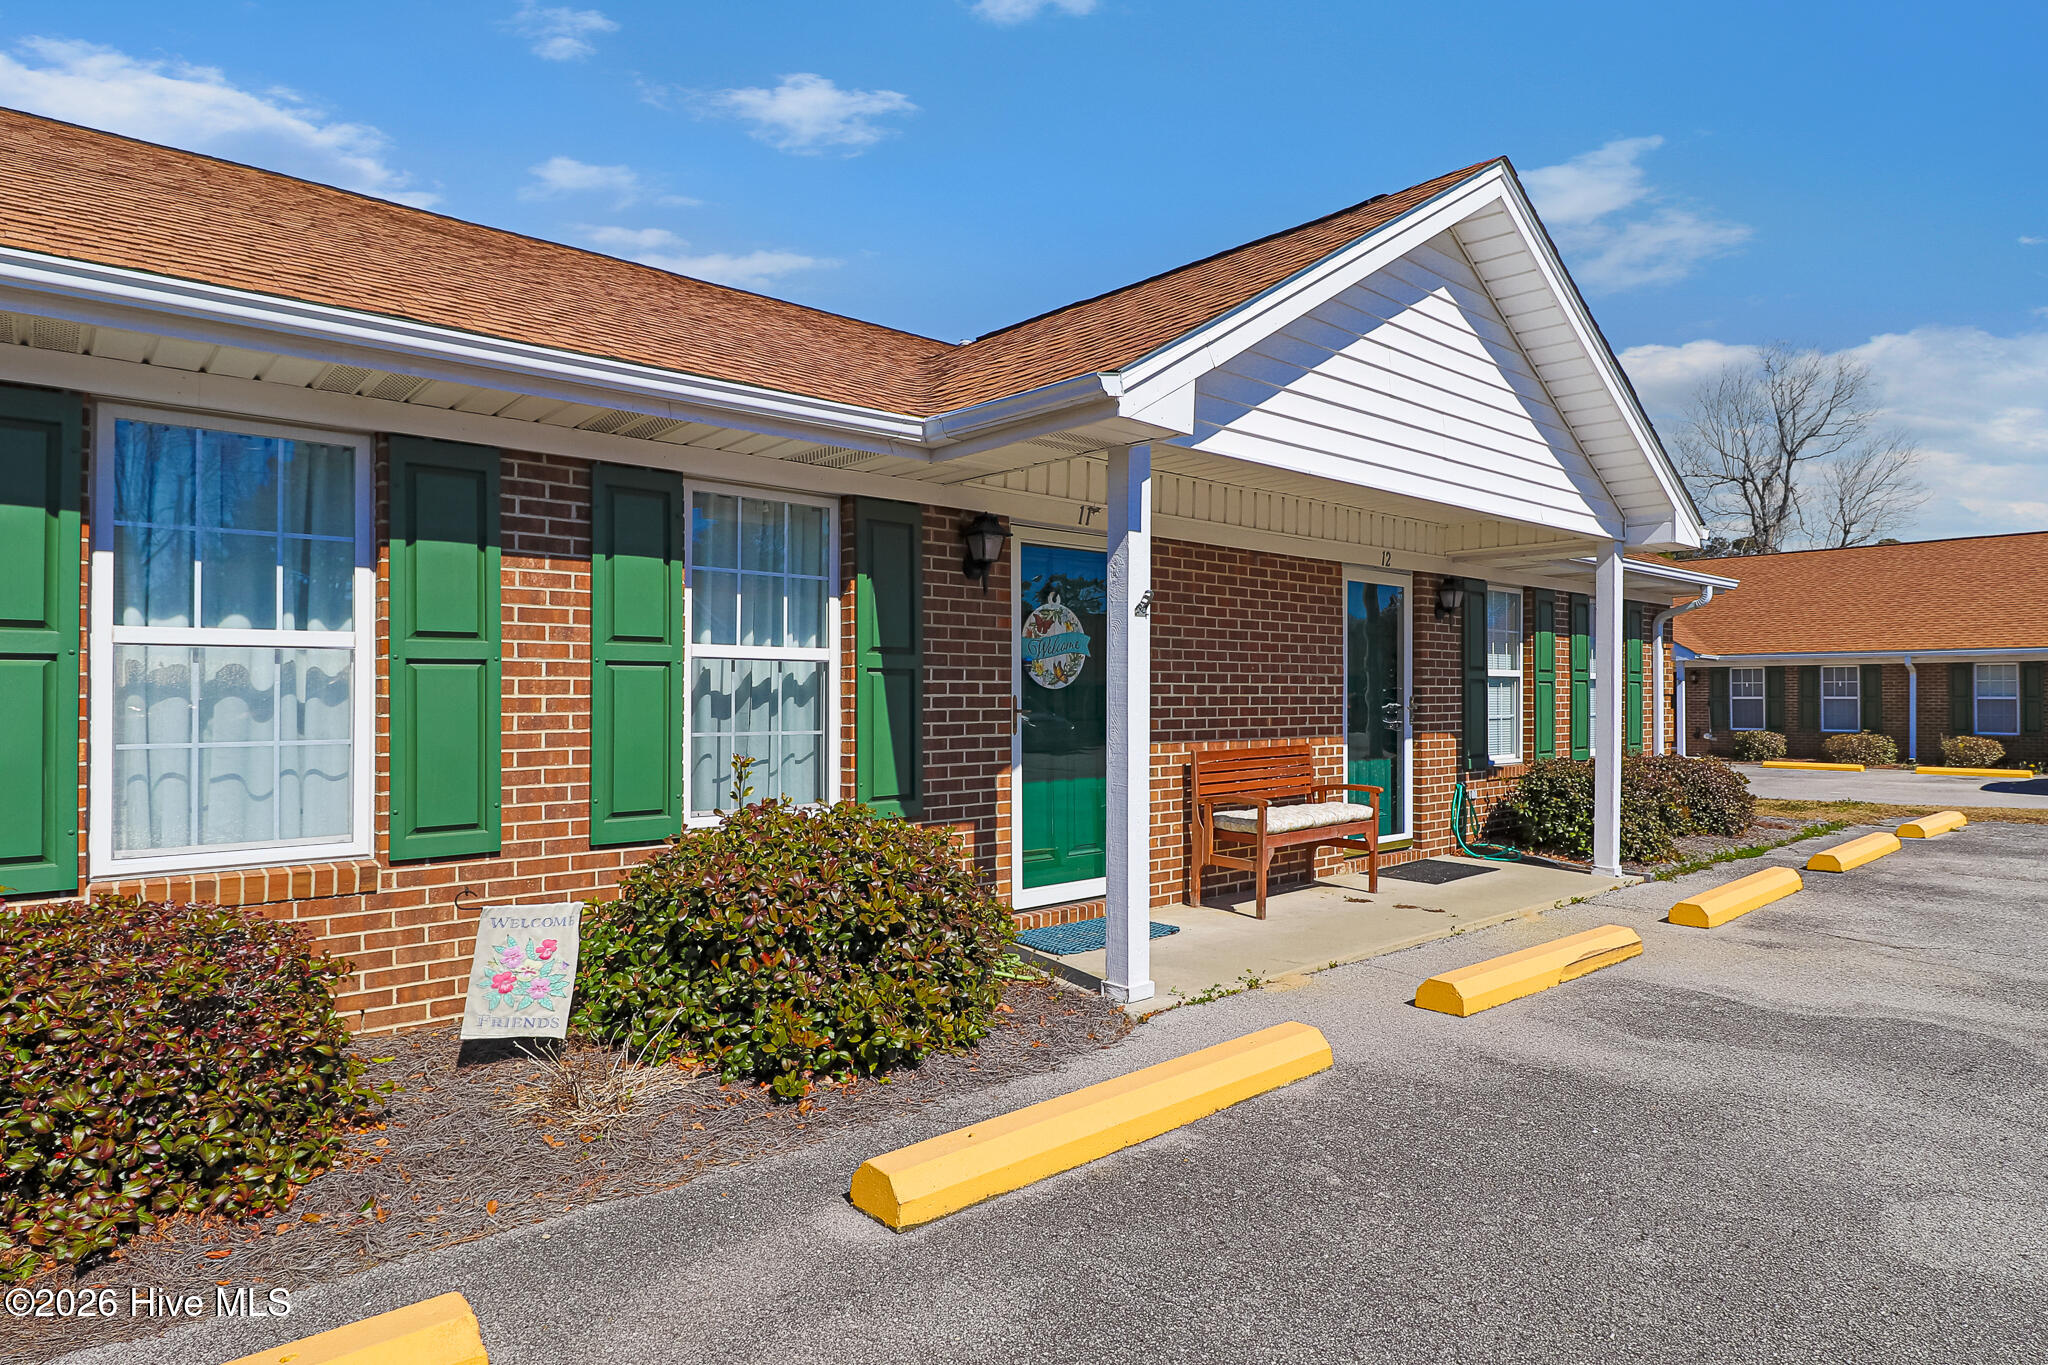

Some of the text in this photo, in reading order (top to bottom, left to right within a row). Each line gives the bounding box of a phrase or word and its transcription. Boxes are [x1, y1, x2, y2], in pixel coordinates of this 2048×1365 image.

[1381, 550, 1392, 567] 12
[1027, 639, 1081, 659] Welcome
[477, 1014, 560, 1029] FRIENDS
